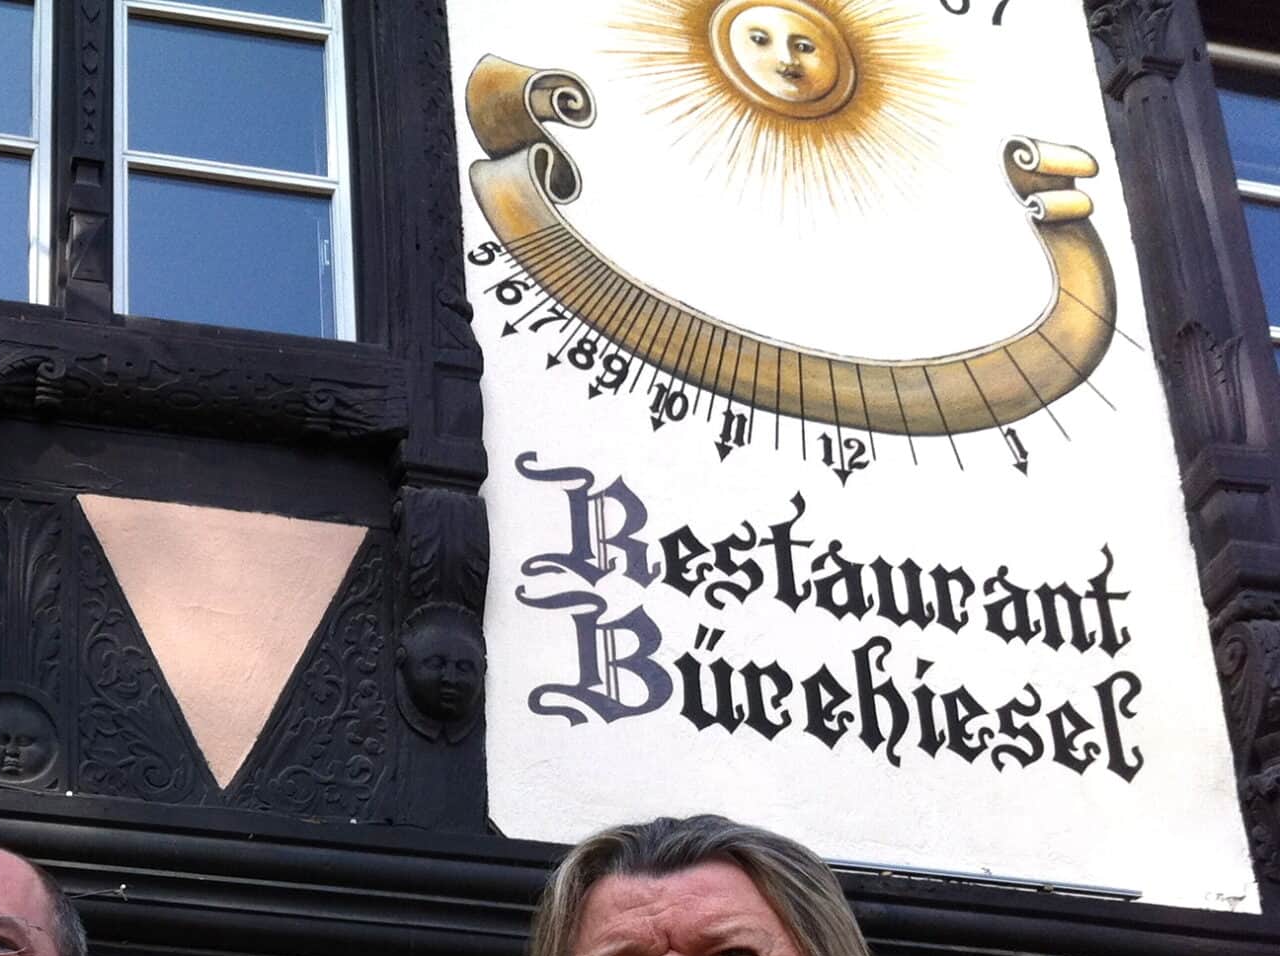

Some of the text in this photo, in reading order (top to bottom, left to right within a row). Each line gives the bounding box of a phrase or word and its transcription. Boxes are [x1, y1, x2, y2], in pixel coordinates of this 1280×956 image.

[467, 241, 503, 266] 5
[495, 279, 531, 306] 6
[527, 302, 570, 333] 7
[567, 338, 598, 370] 8
[595, 353, 629, 390] 9
[649, 382, 688, 422] 10
[819, 432, 870, 471] 12
[515, 450, 1131, 659] Restaurant
